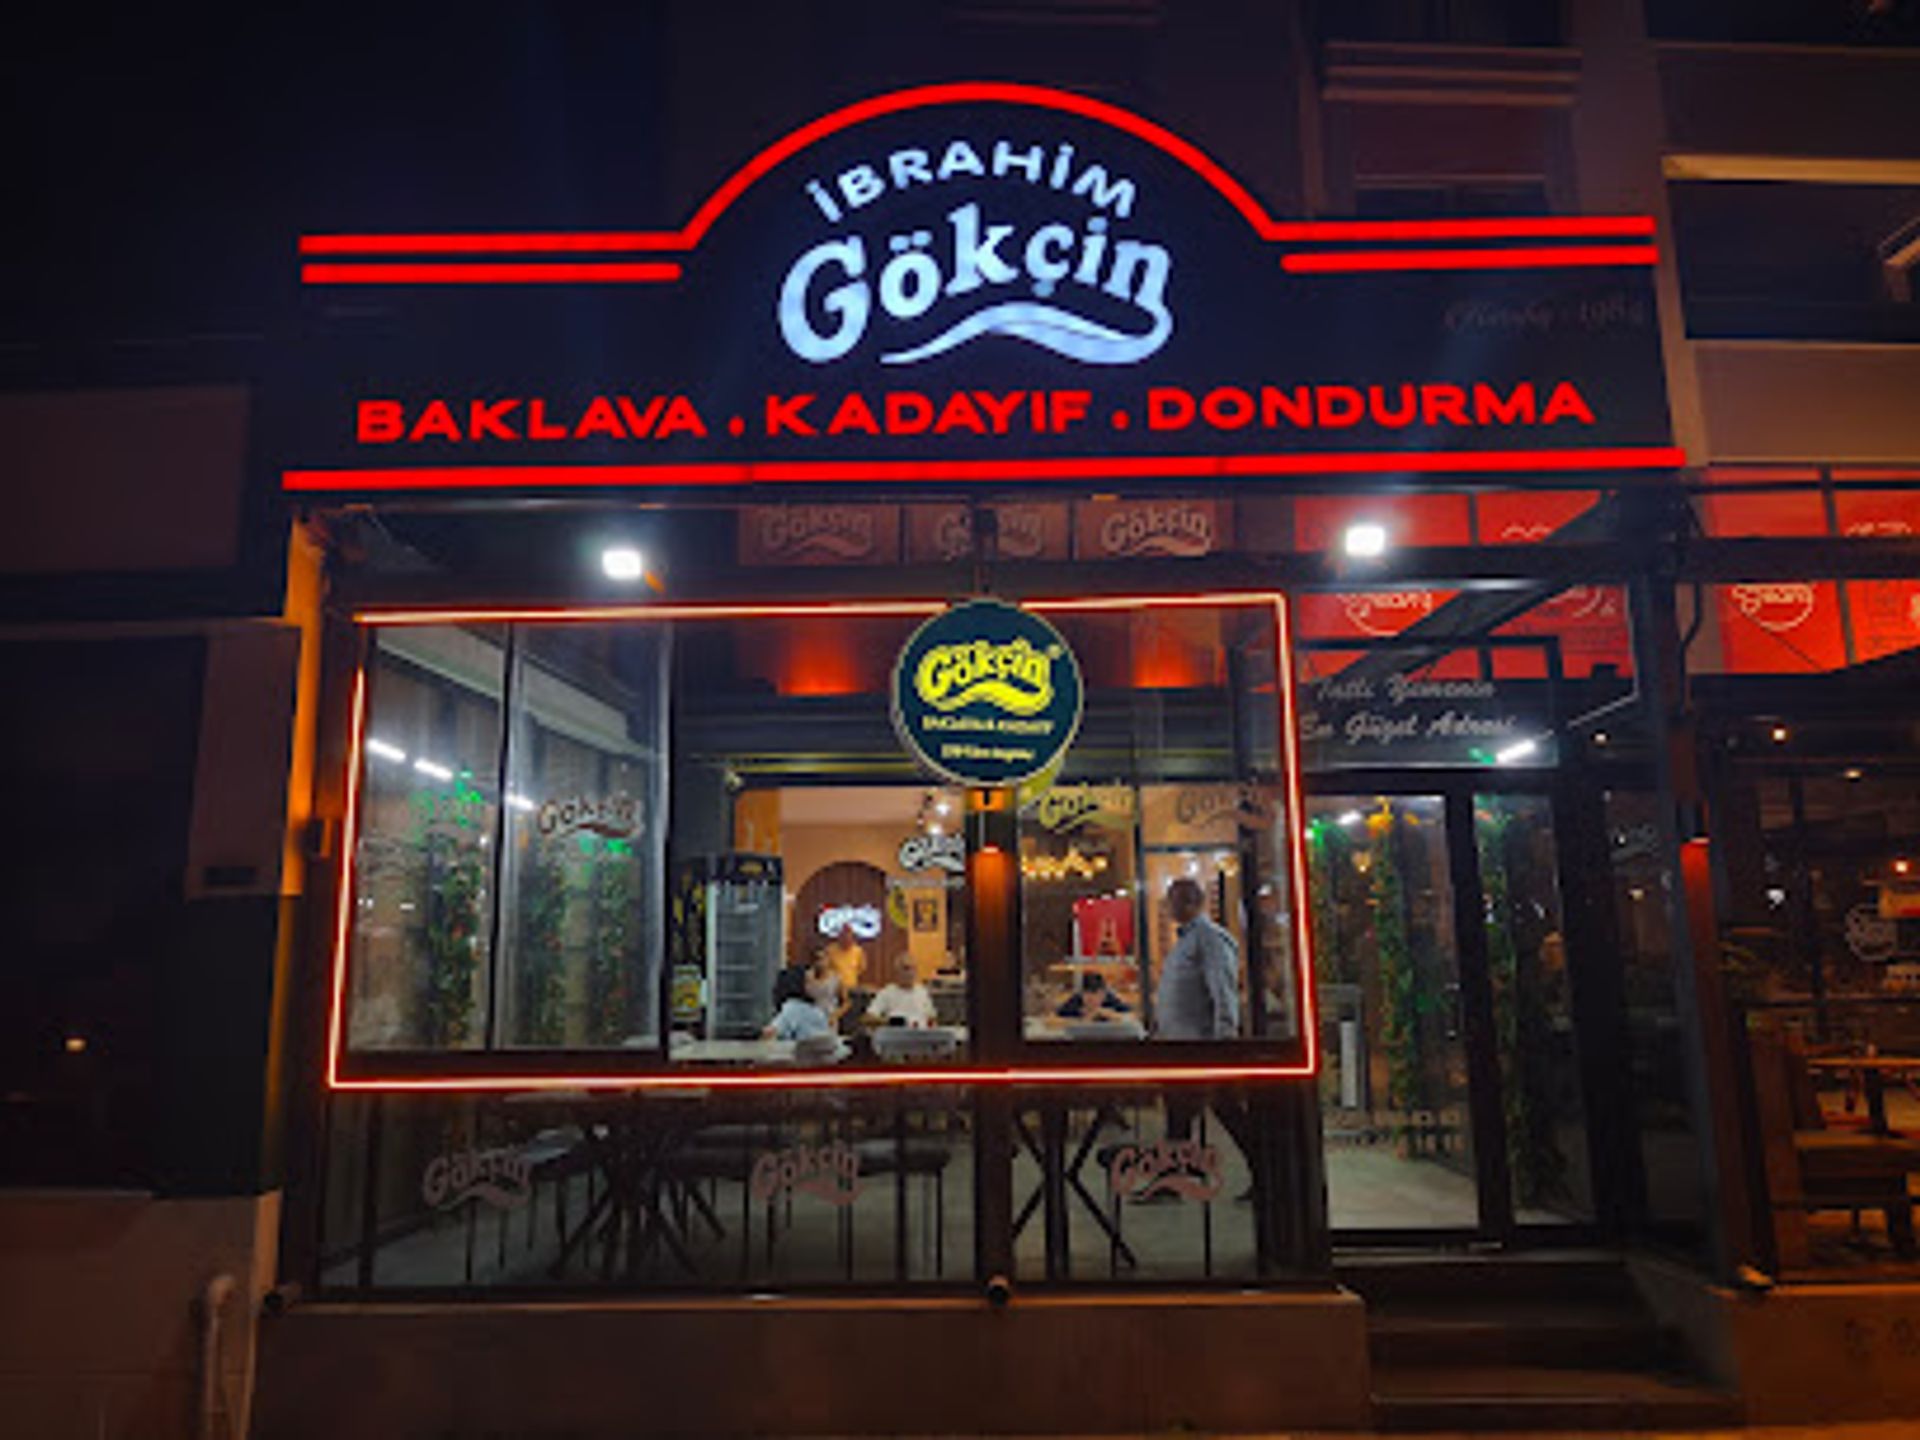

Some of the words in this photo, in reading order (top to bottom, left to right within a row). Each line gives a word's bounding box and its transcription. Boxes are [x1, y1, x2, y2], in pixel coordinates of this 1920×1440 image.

[805, 140, 1137, 223] İBRAHİM
[778, 203, 1174, 365] Gökçin
[357, 394, 707, 441] BAKLAVA
[765, 391, 1092, 435] KADAYIF
[1148, 382, 1595, 430] DONDURMA
[1100, 505, 1212, 559] Gökçin
[914, 637, 1055, 715] Gökçin
